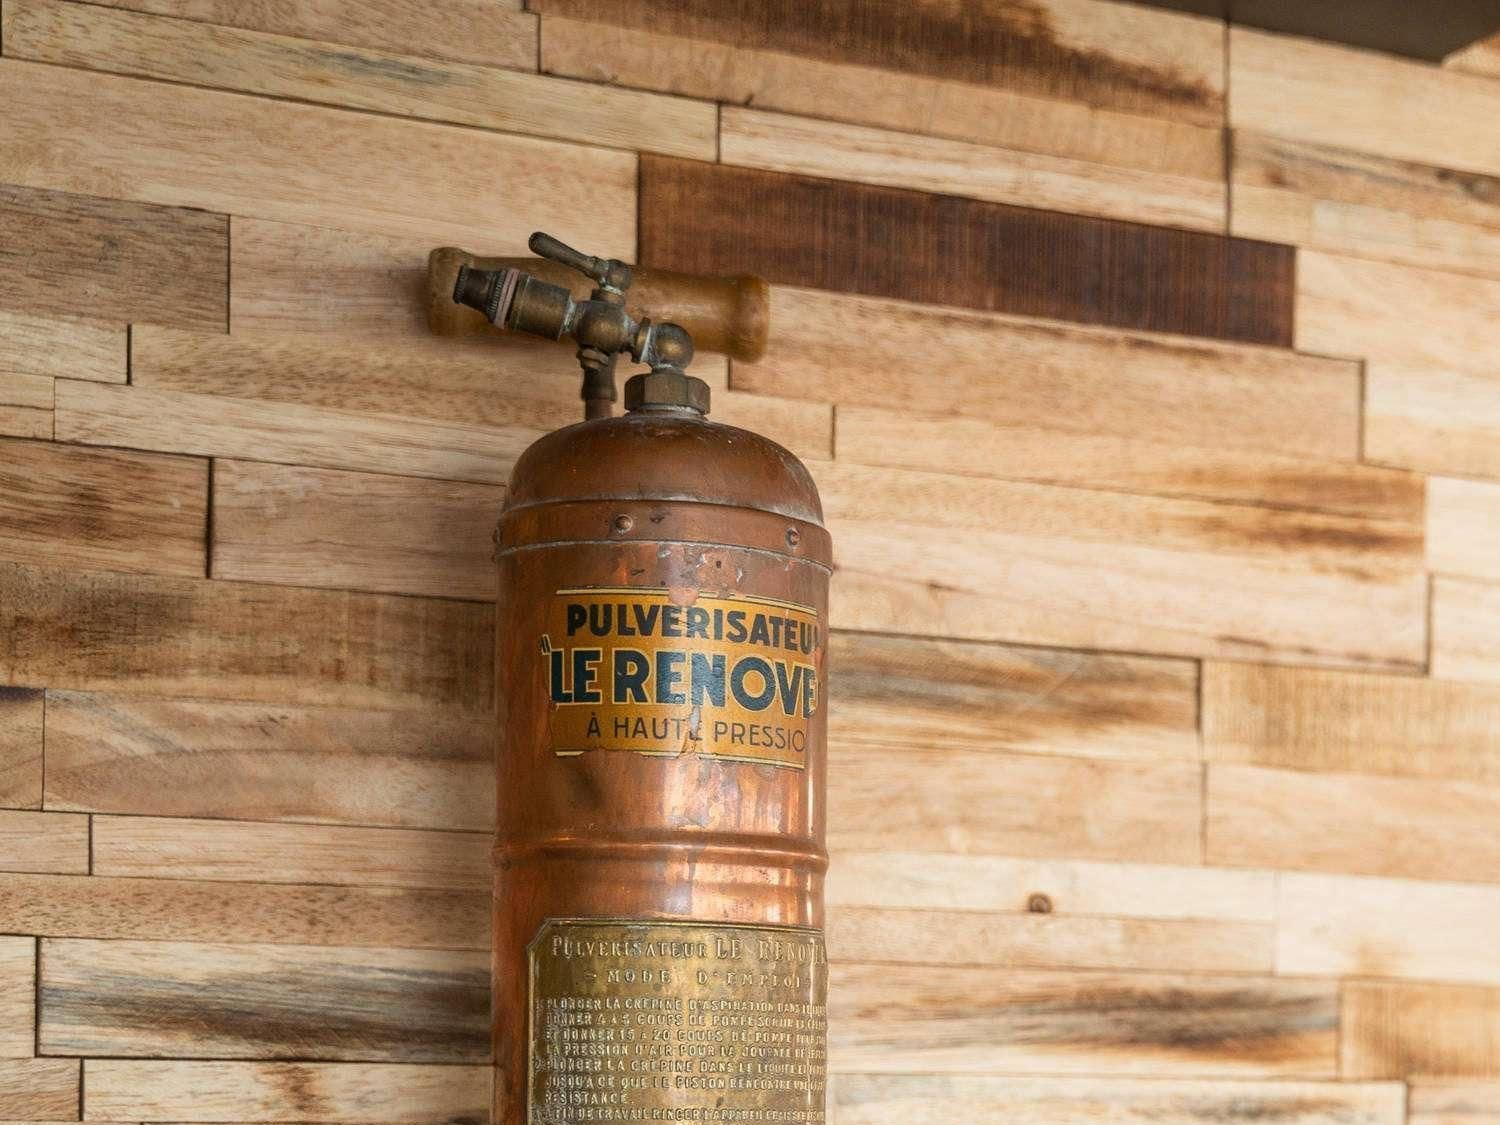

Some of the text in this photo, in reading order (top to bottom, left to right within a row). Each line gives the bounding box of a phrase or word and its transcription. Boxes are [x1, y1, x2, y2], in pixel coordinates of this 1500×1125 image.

[715, 721, 807, 752] PRESSIO
[552, 935, 706, 958] PULVERISATEUR
[716, 938, 741, 960] LE
[608, 969, 670, 984] MODE
[606, 998, 620, 1010] LA
[637, 1013, 683, 1027] COUPS
[688, 1014, 705, 1026] DE
[563, 1028, 615, 1041] DONNER
[653, 1028, 673, 1042] 20
[564, 1043, 629, 1057] PRESSION
[679, 1045, 716, 1058] POUR
[720, 1047, 736, 1058] LA
[606, 1060, 626, 1073] LA
[700, 1061, 736, 1074] DANS
[621, 1076, 649, 1089] QUE
[653, 1077, 670, 1089] LE
[675, 1077, 726, 1089] PISTON
[597, 1107, 648, 1120] TRAVAIL
[652, 1108, 702, 1121] RINCER
